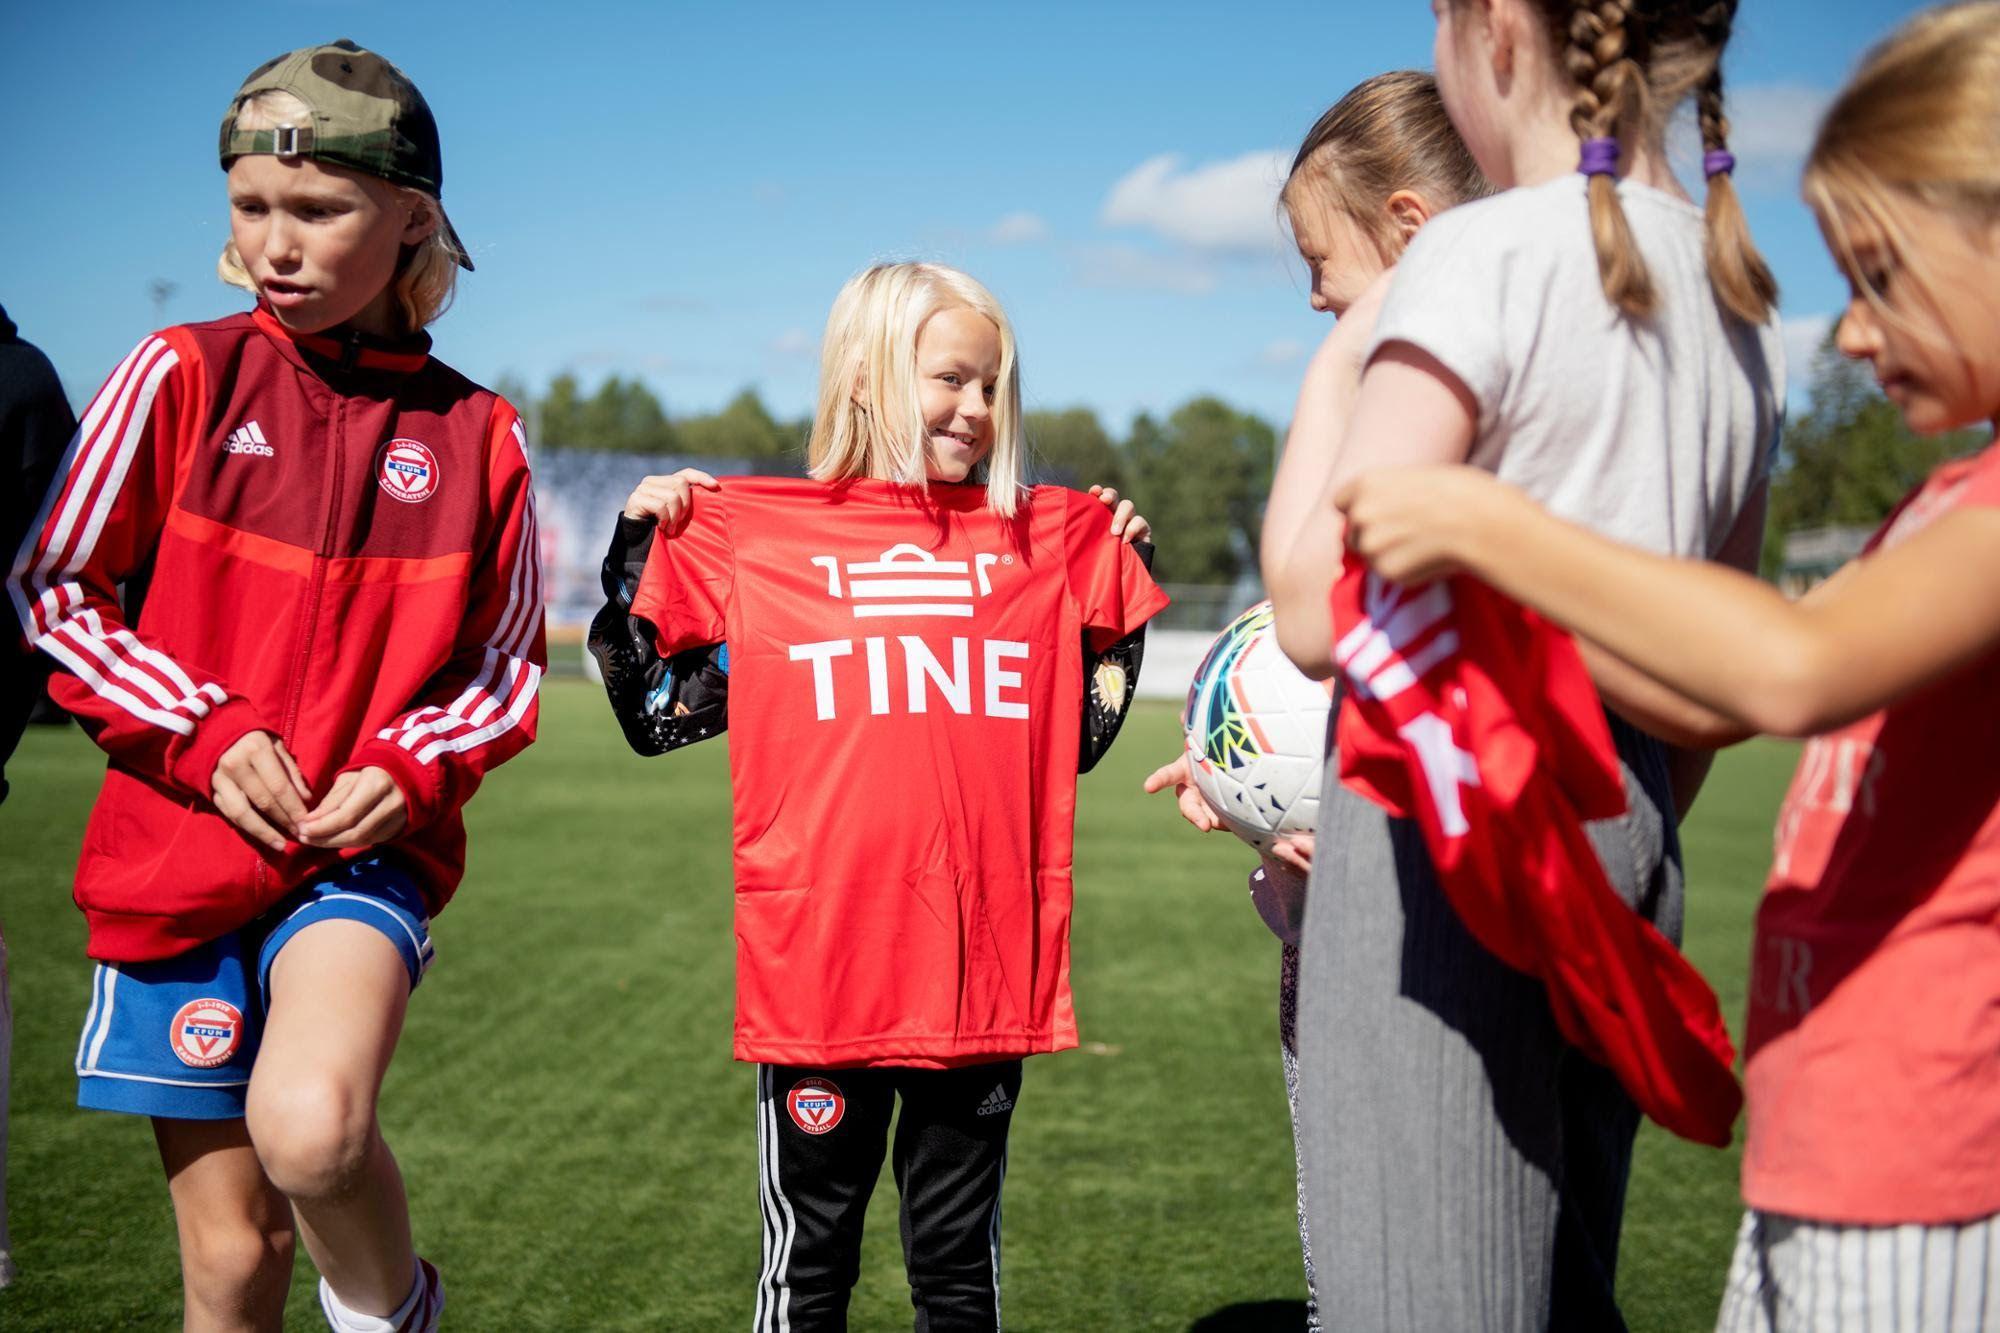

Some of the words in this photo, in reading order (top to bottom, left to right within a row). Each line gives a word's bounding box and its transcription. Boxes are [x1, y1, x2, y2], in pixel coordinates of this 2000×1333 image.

[222, 440, 275, 457] adidas
[395, 464, 421, 474] KFUM
[788, 635, 1030, 721] TINE
[193, 1028, 223, 1037] KFUM
[976, 1099, 1012, 1116] adidas
[803, 1123, 832, 1133] FOTBALL
